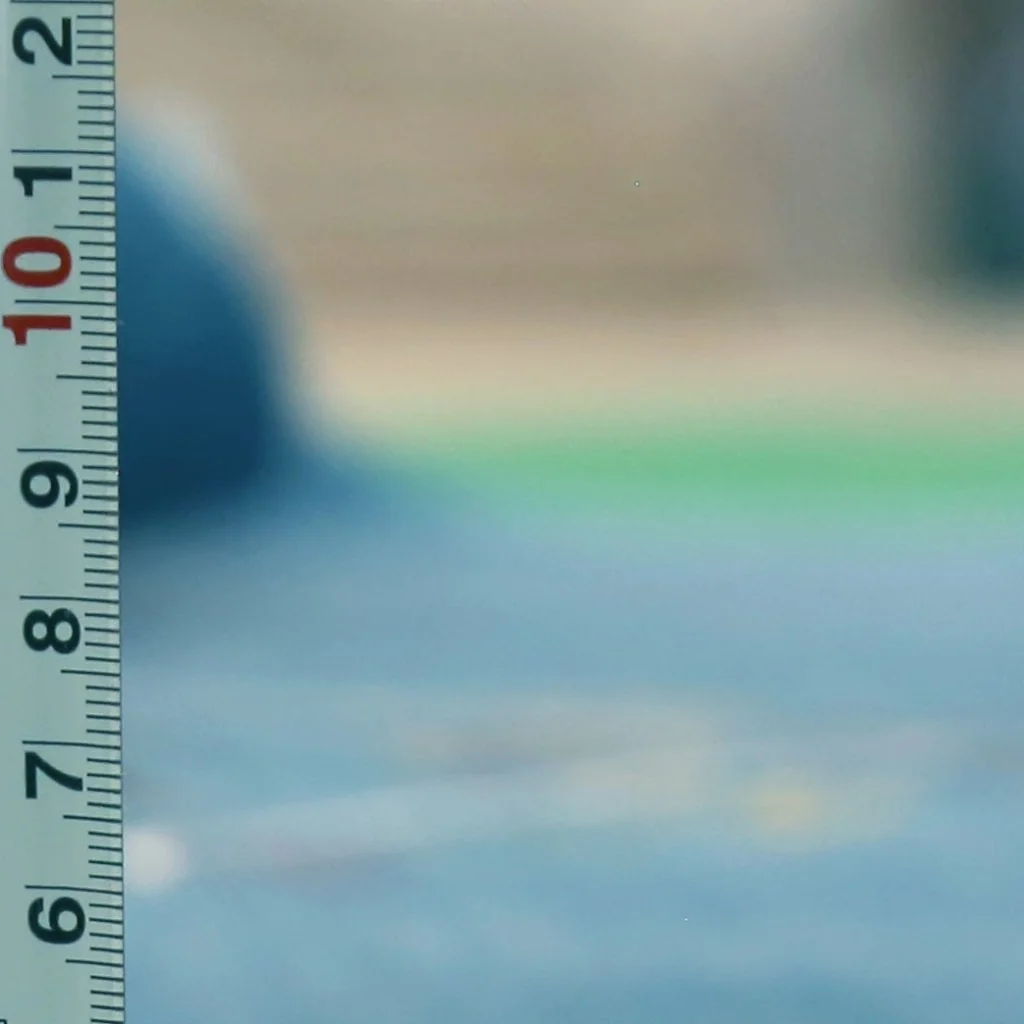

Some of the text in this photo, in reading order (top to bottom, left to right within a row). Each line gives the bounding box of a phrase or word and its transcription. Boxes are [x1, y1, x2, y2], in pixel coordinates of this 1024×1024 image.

[12, 17, 72, 66] 2
[13, 166, 73, 197] 1
[1, 236, 73, 345] 10
[20, 460, 79, 509] 9
[22, 608, 81, 655] 8
[25, 751, 83, 799] 7
[28, 896, 86, 944] 6
